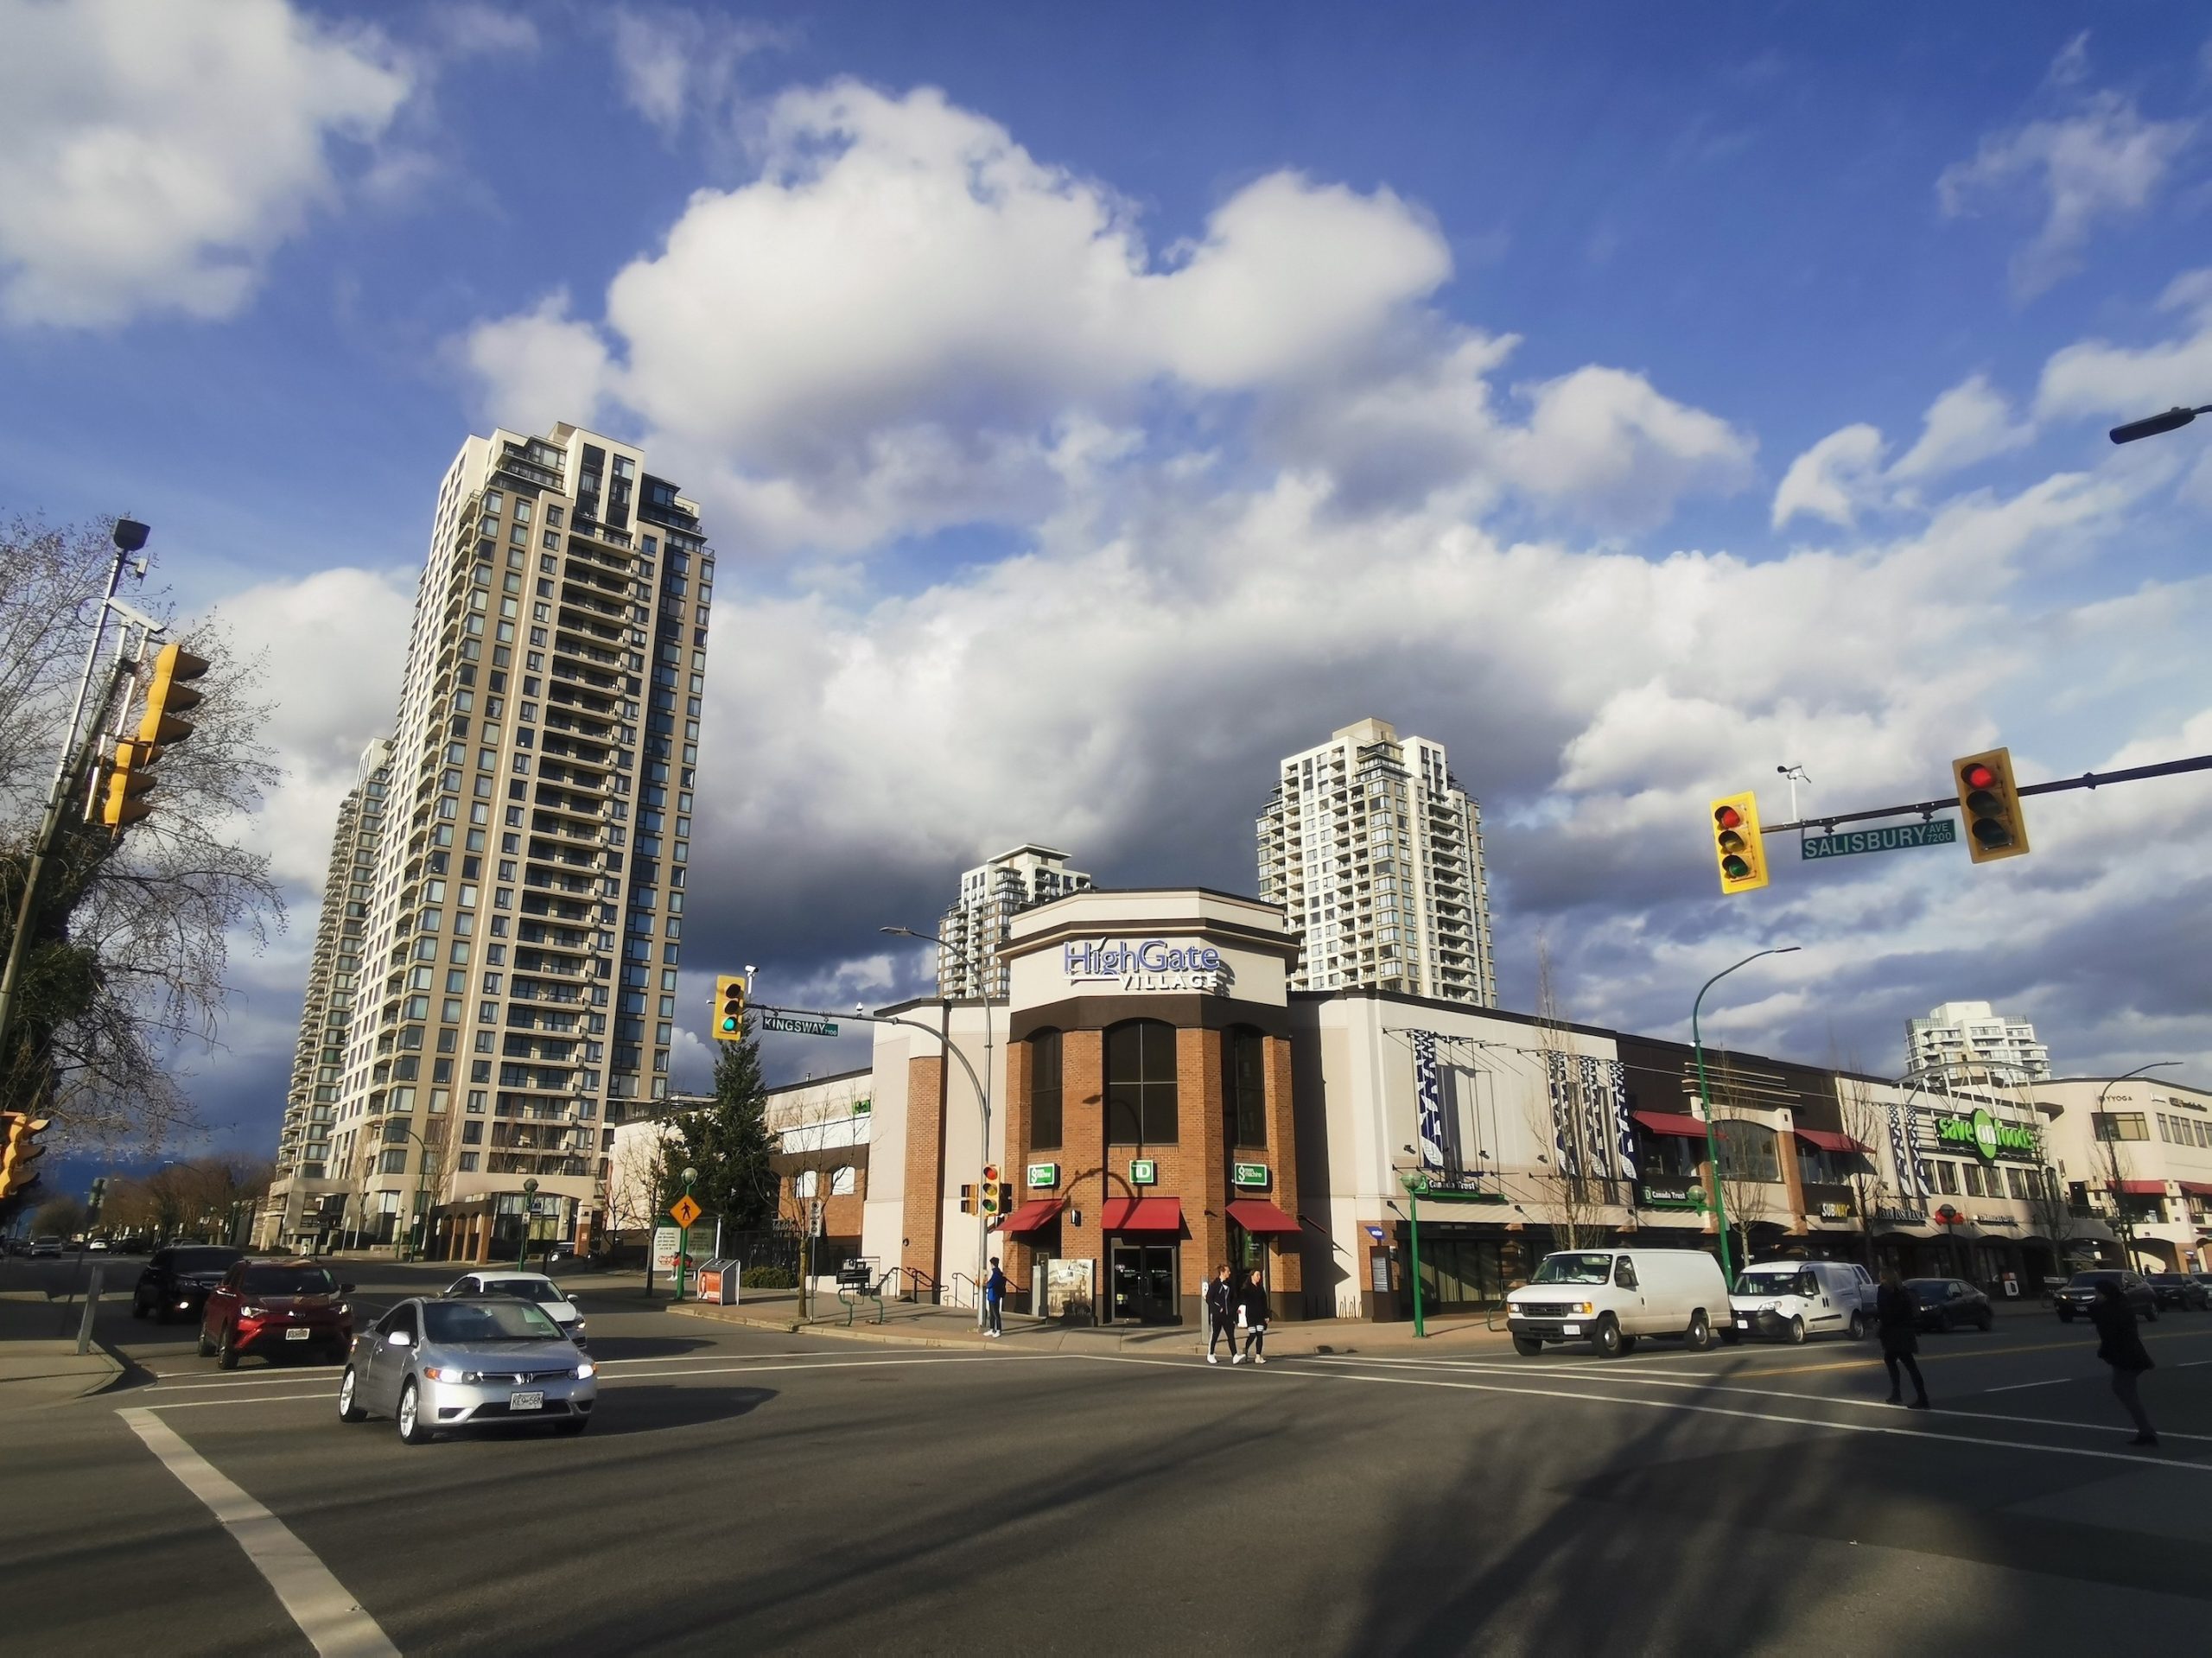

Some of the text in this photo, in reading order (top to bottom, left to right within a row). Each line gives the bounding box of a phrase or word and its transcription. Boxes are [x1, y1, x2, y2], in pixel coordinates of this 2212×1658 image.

[1929, 823, 1949, 833] AVE
[1805, 825, 1928, 858] SALISBURY
[1928, 832, 1951, 843] 7200
[1064, 937, 1220, 975] HighGate
[1118, 970, 1217, 991] VILLAGE
[765, 1018, 826, 1034] KINGSWAY
[1939, 1118, 1975, 1142] save
[1977, 1124, 1997, 1145] on
[1133, 1164, 1151, 1178] TD
[1428, 1179, 1455, 1189] Canada
[1457, 1180, 1476, 1190] Trust
[1821, 1203, 1849, 1217] SUBWAY
